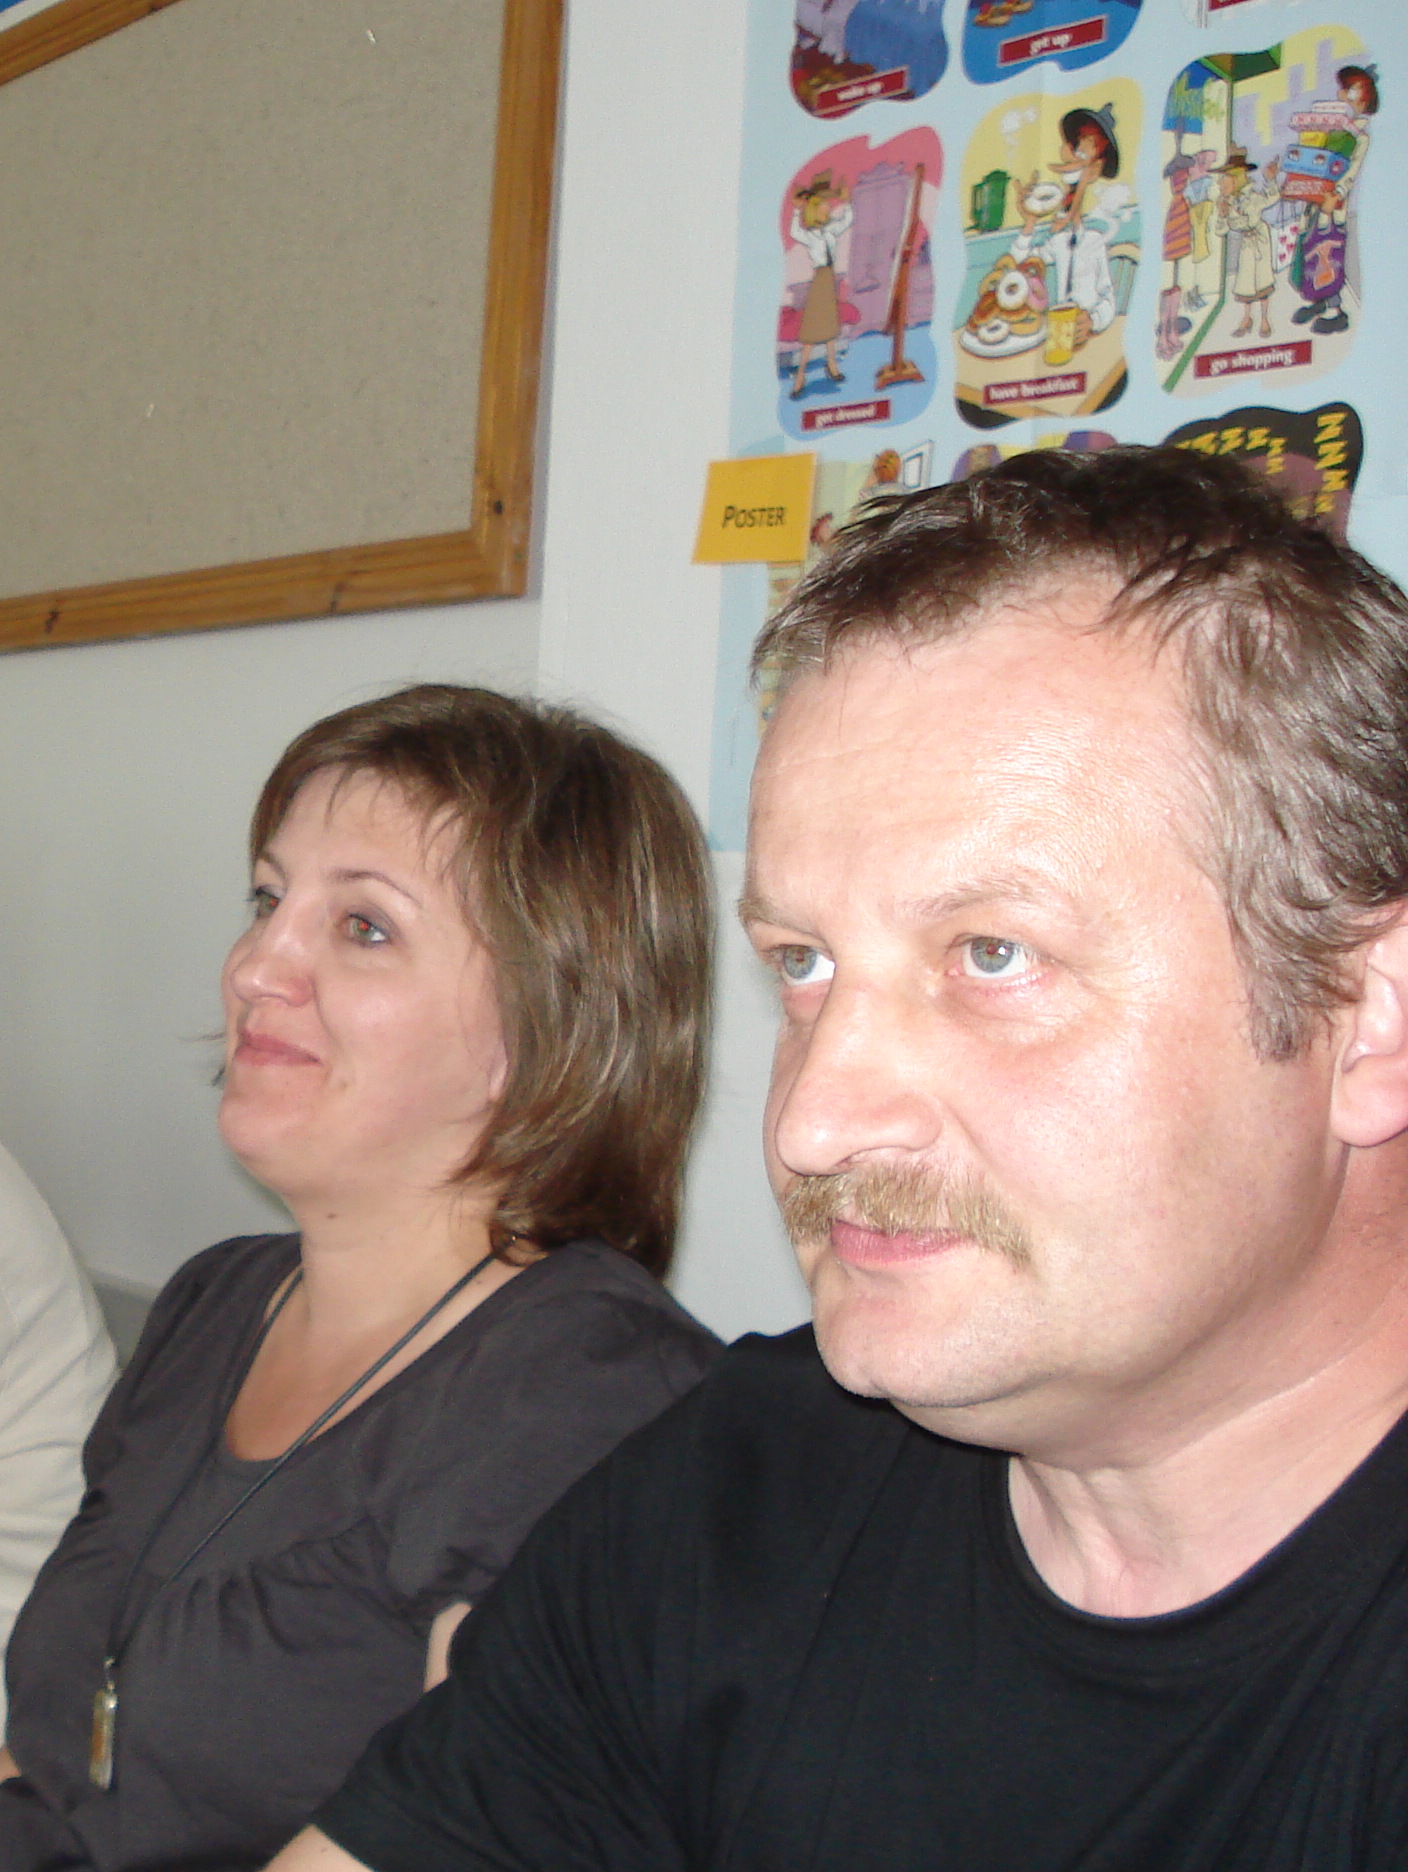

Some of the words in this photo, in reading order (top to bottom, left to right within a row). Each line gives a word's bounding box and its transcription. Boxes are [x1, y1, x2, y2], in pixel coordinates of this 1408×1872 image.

[1052, 33, 1072, 48] up
[1210, 358, 1228, 376] go
[1232, 348, 1295, 370] shopping
[989, 385, 1019, 400] have
[1021, 378, 1079, 397] breakfast
[721, 505, 786, 529] POSTER
